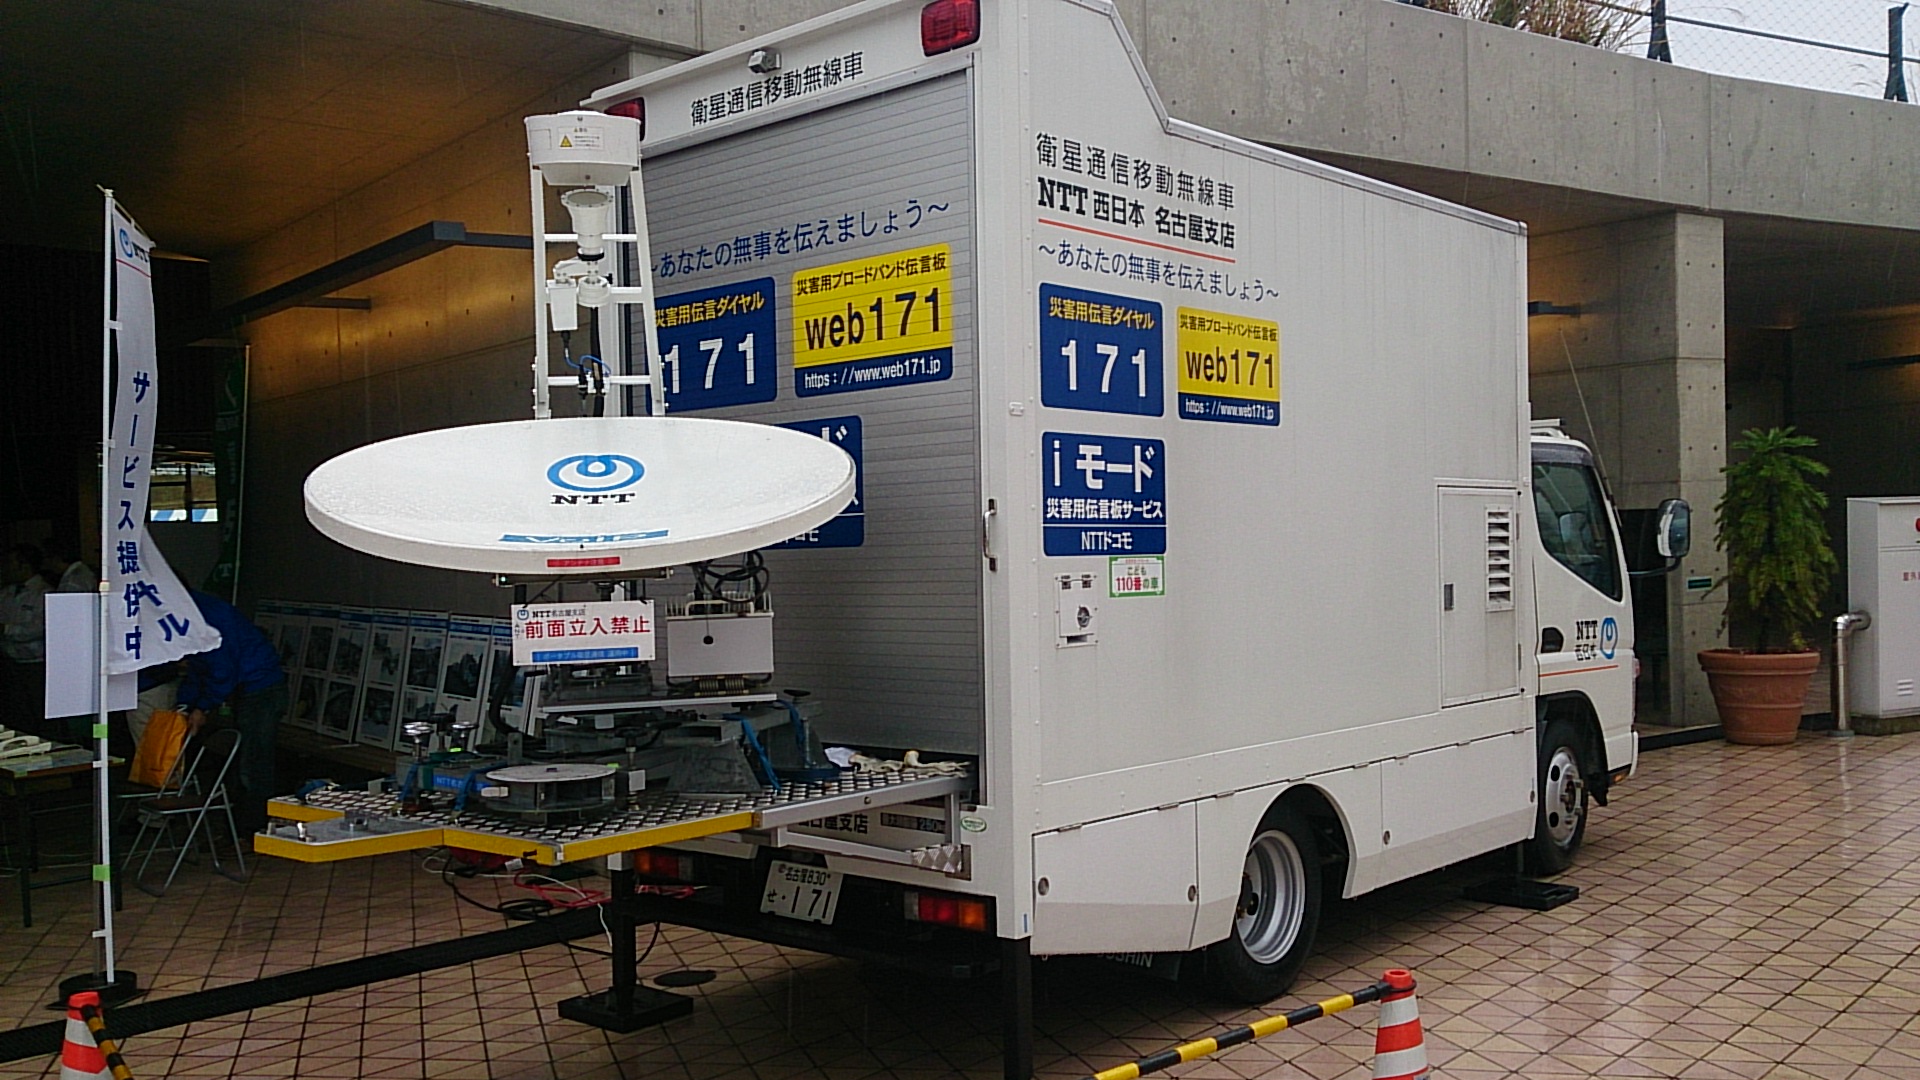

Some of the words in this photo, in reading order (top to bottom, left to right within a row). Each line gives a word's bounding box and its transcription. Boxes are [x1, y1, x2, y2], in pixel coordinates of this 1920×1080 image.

[690, 50, 864, 127] 衛星通信移動無線車
[1036, 131, 1235, 211] 衛星通信移動無線車
[1154, 205, 1235, 249] 名古屋支店
[796, 252, 946, 296] 災害用ブロードバンド伝言板
[655, 291, 765, 328] 災害用伝言ダイヤル
[805, 286, 939, 350] web171
[1049, 296, 1155, 330] 災害用伝言ダイヤル
[1180, 314, 1278, 342] 災害用ブロードバンド伝言板
[1186, 346, 1273, 389] web171
[551, 493, 635, 505] NTT
[1046, 497, 1163, 519] 災害用伝言板サービス
[1081, 531, 1133, 551] NTTドコモ
[1127, 565, 1147, 576] こども
[524, 615, 652, 639] 前面立入禁止
[1576, 620, 1597, 640] NTT
